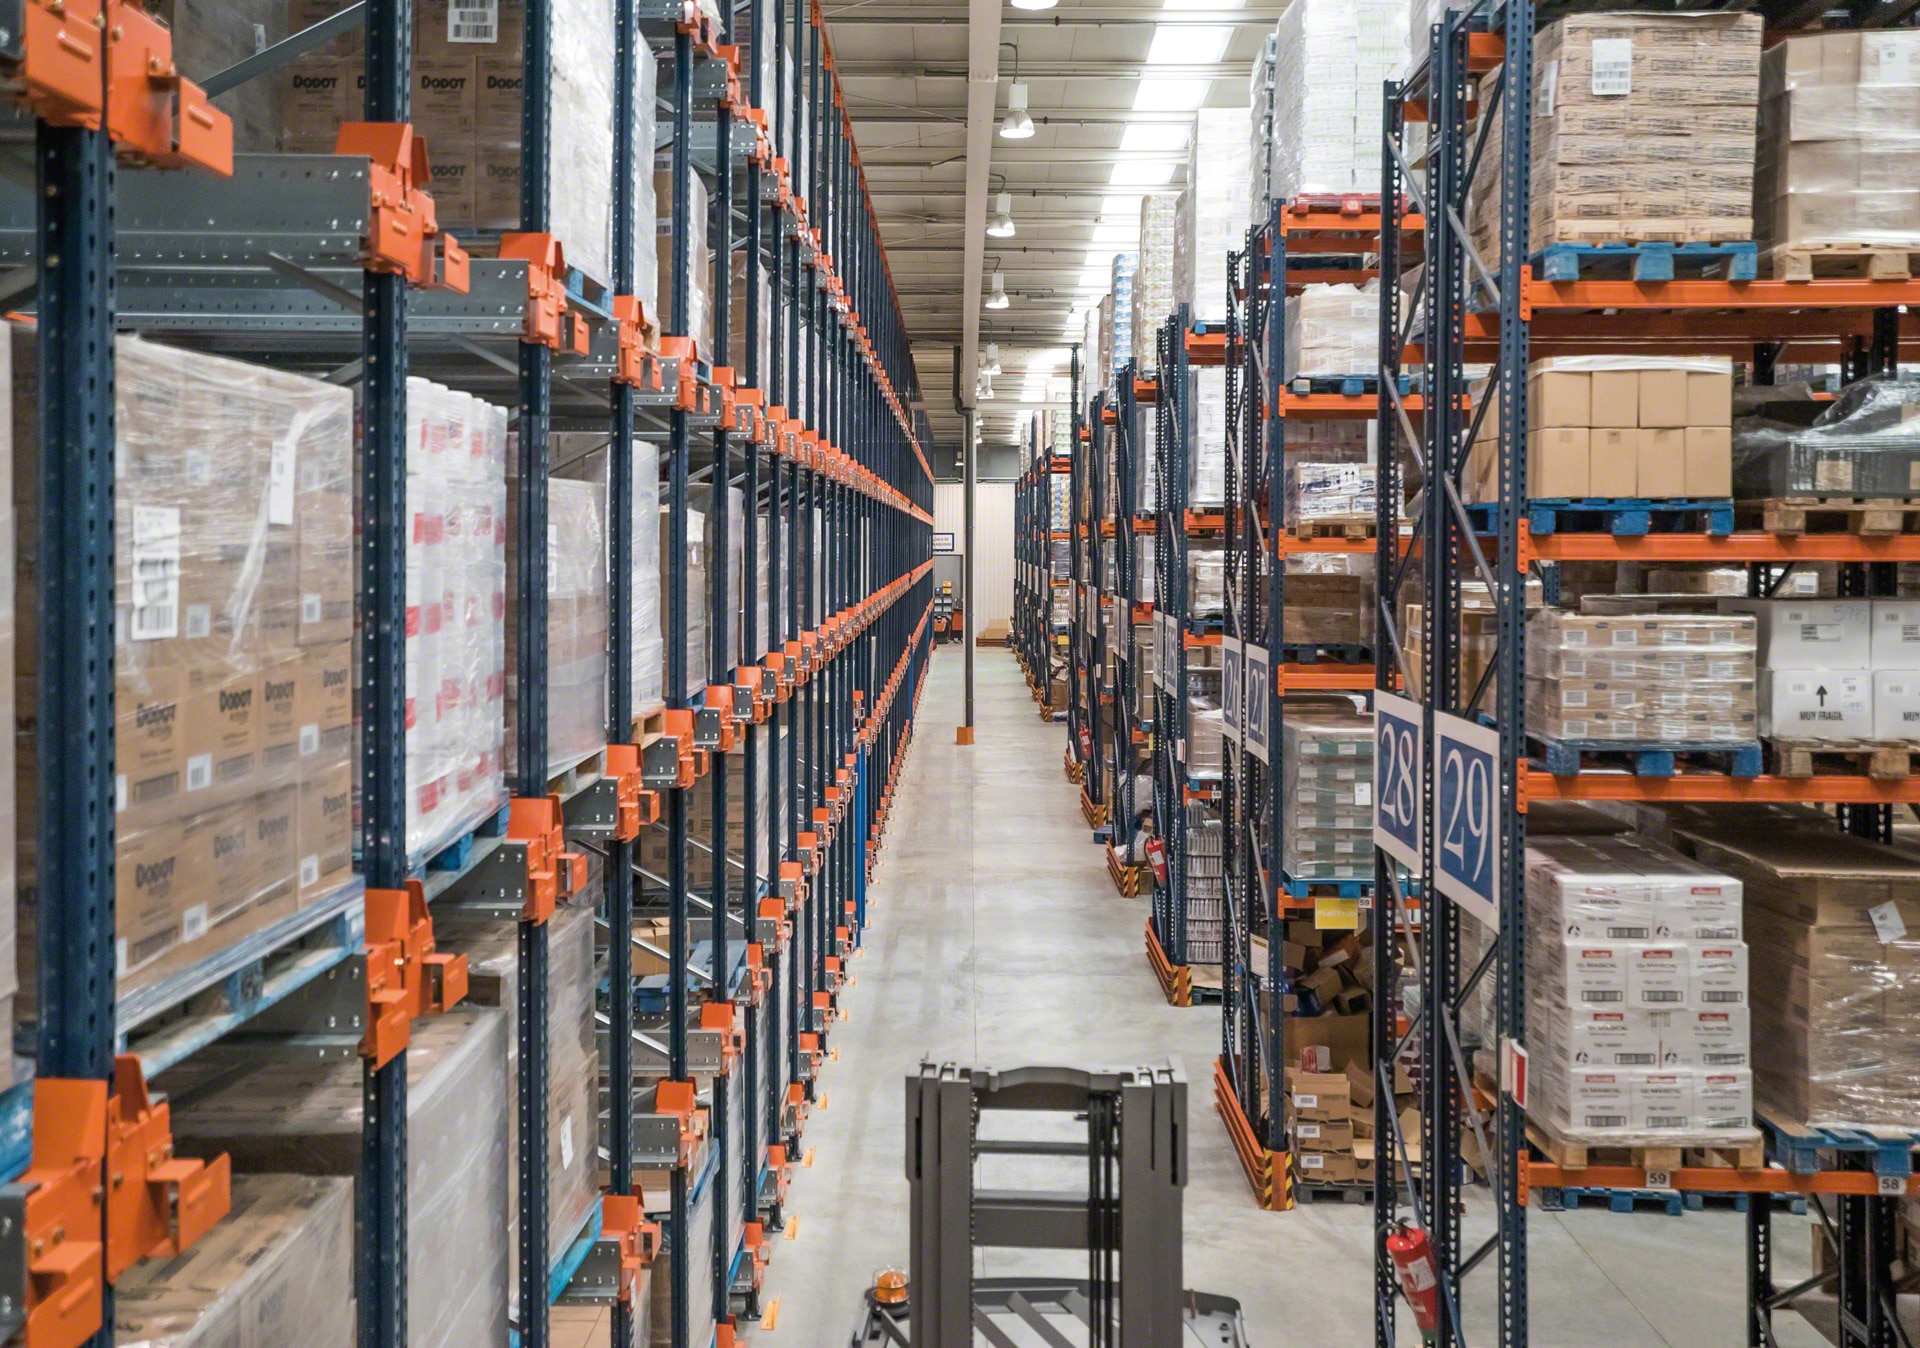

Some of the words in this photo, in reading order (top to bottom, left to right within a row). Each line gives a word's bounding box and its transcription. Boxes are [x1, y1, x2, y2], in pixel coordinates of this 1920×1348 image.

[293, 74, 337, 89] DODOT
[421, 75, 466, 89] DODOT
[487, 75, 523, 89] DODO
[431, 164, 466, 177] ODOT
[487, 163, 521, 177] DODO
[1226, 656, 1240, 721] 26
[219, 689, 253, 713] DODOT
[1250, 667, 1266, 736] 27
[1800, 711, 1816, 721] MUY
[1818, 711, 1844, 721] FRAGIL
[1381, 722, 1414, 828] 28
[1443, 748, 1489, 882] 29
[1649, 1172, 1667, 1185] 59
[1881, 1178, 1899, 1190] 58
